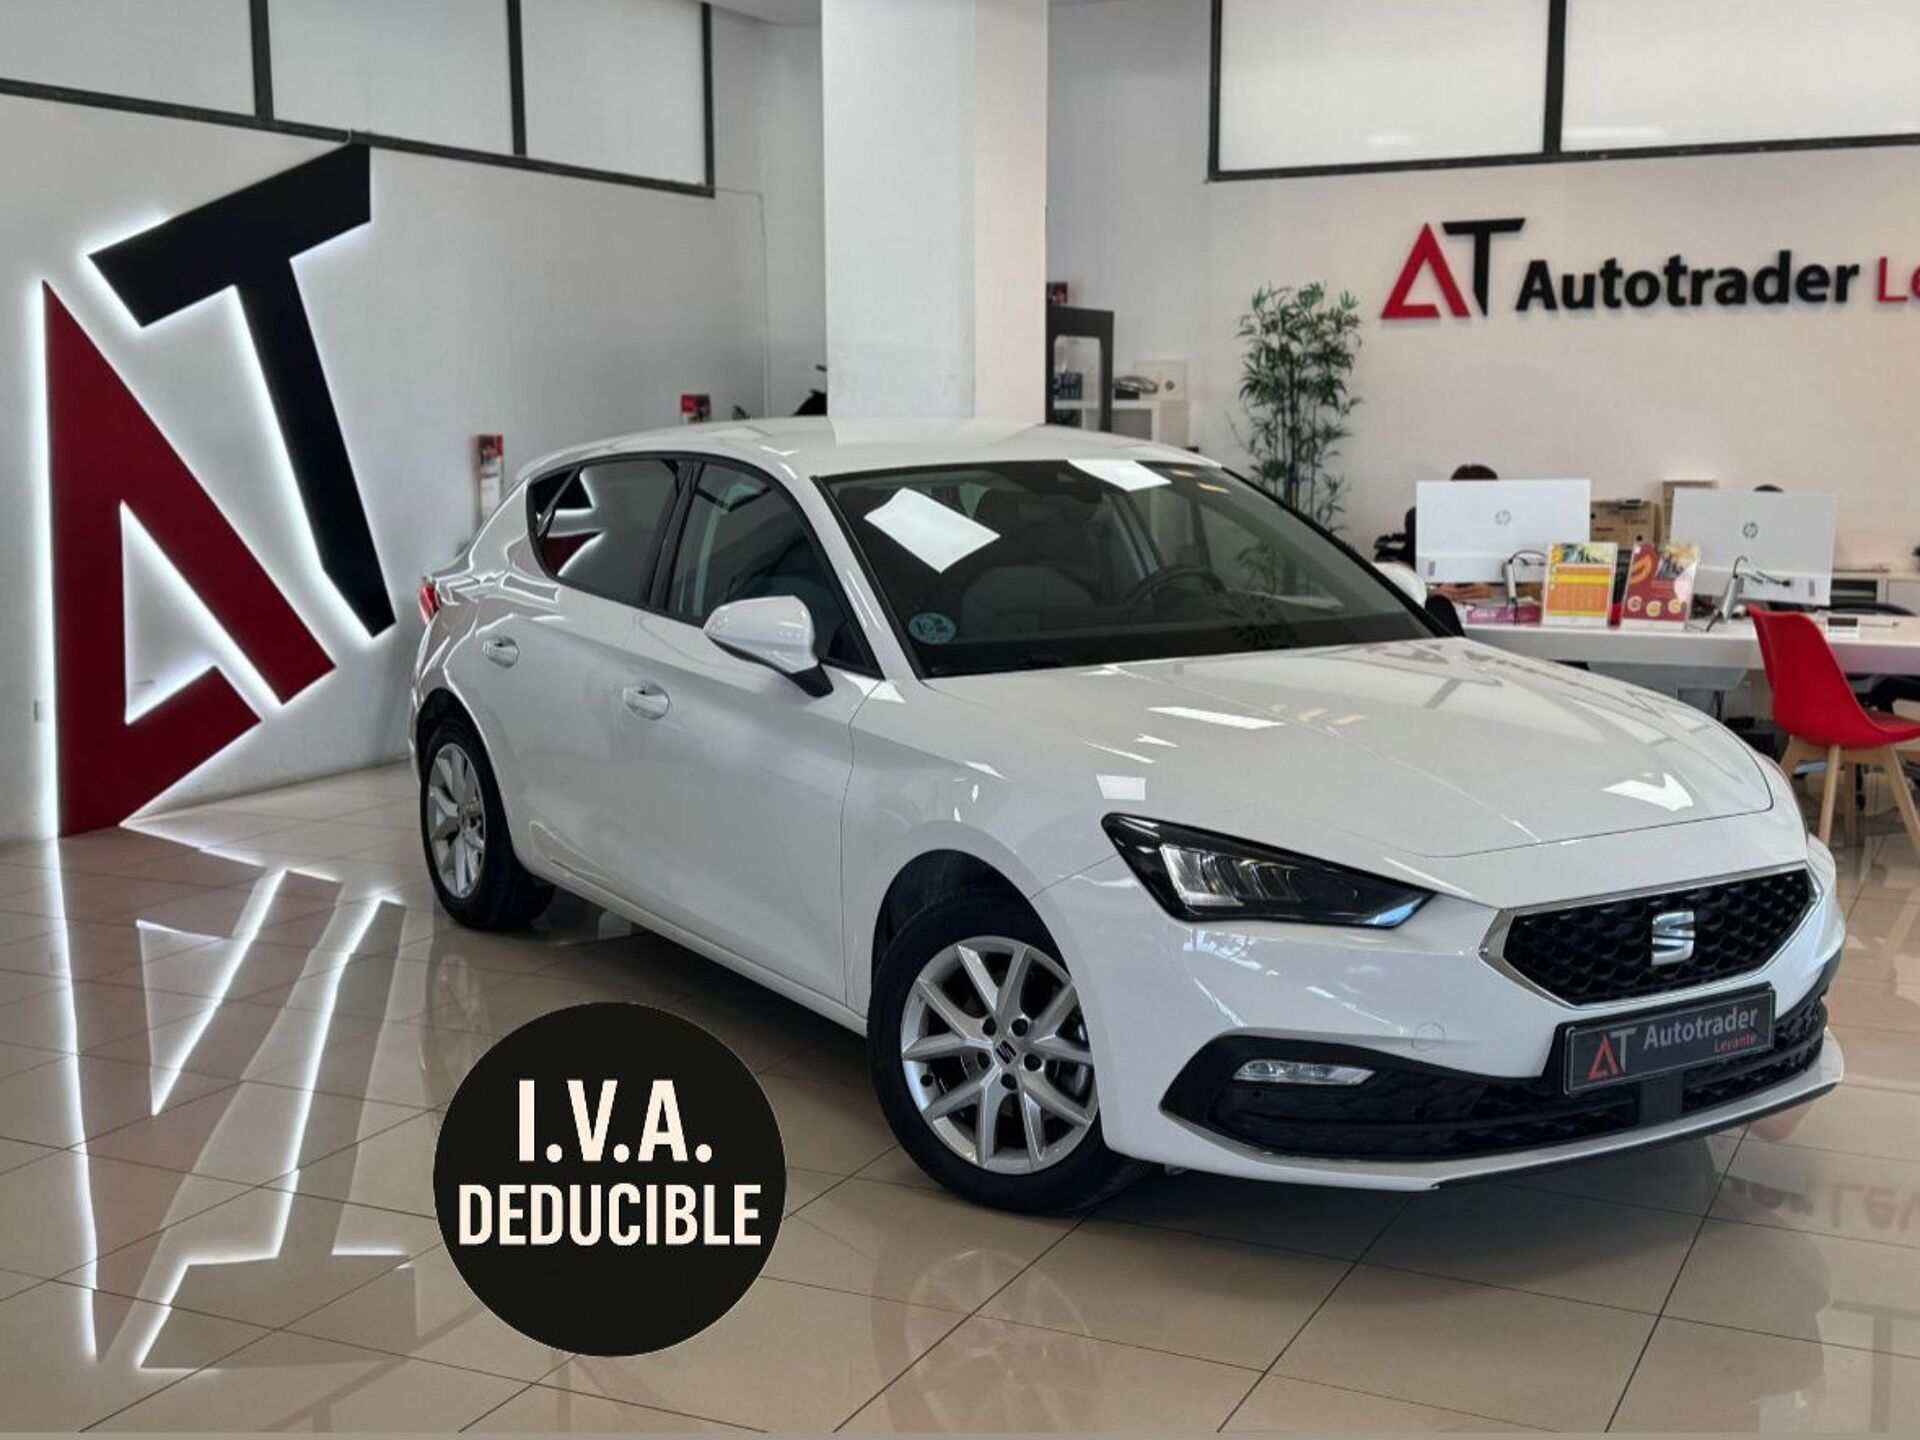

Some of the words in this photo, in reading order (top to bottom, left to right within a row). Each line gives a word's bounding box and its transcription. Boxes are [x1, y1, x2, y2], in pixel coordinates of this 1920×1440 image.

[1380, 217, 1526, 319] AT
[1515, 249, 1860, 312] Autotrader
[42, 143, 397, 838] AT
[1588, 1027, 1638, 1081] AT
[1643, 1005, 1759, 1050] Autotrader
